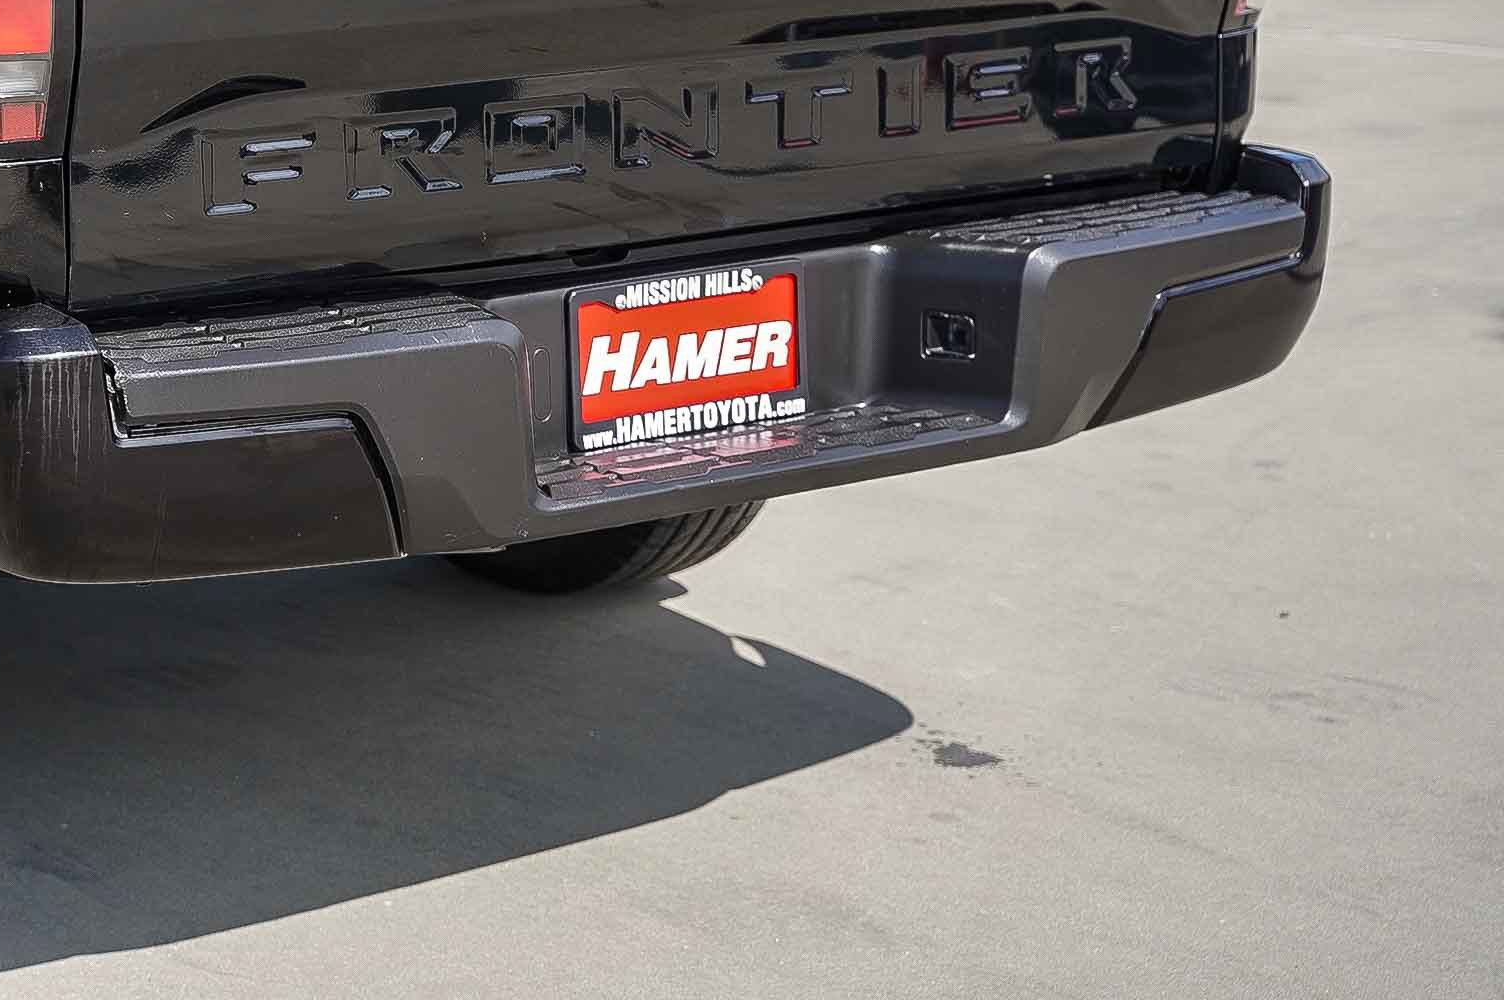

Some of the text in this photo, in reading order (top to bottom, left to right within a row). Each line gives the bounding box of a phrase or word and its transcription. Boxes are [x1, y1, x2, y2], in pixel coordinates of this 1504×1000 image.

[200, 36, 1139, 218] FRONTIER
[626, 267, 753, 309] MISSION HILLS
[582, 320, 793, 396] HAMER
